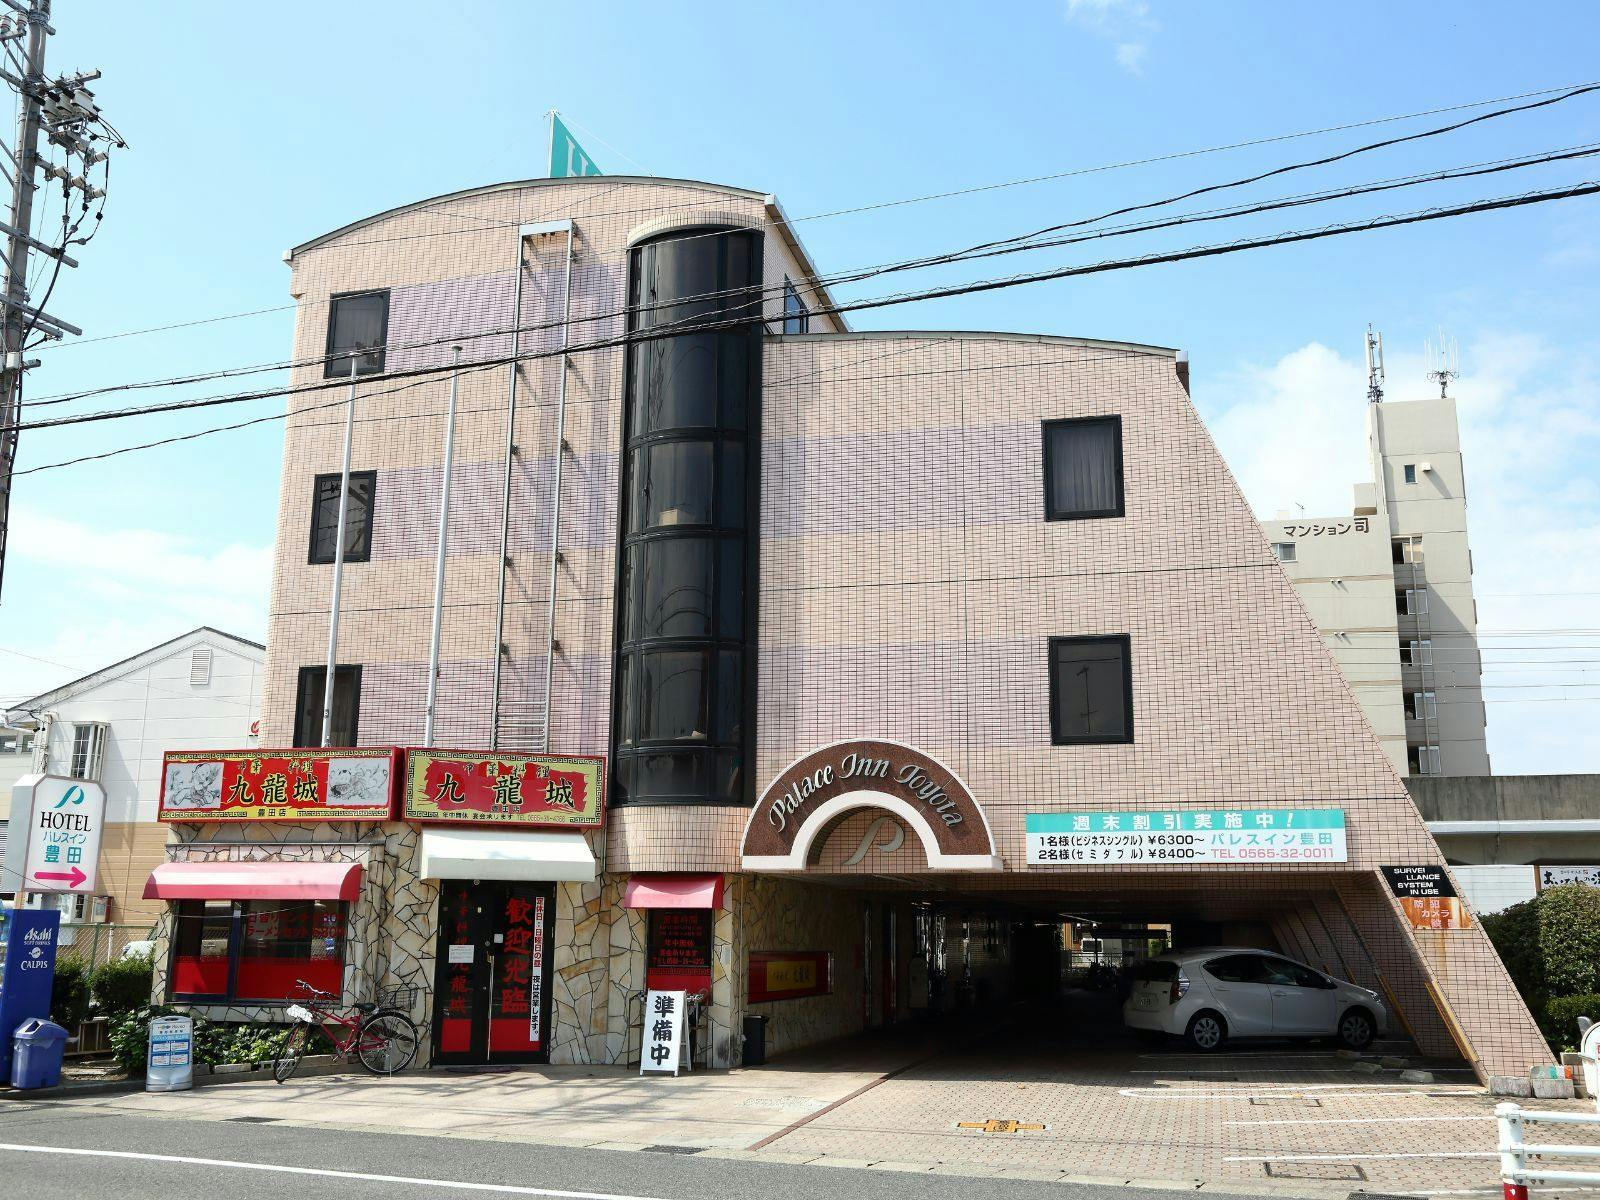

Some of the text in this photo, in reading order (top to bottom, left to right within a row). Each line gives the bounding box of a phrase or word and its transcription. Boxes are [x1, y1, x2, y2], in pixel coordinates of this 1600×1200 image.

[1284, 518, 1369, 537] マンション司
[227, 773, 319, 804] 九龍城
[434, 773, 575, 808] 九龍城
[769, 753, 964, 833] Palace Inn Toyota
[40, 811, 92, 832] HOTEL
[44, 845, 82, 864] 豊田
[1211, 848, 1235, 859] TEL
[1239, 848, 1334, 859] 0565-32-0011
[1397, 881, 1433, 889] SYSTEM
[1422, 909, 1450, 918] カメラ
[24, 928, 52, 941] Asahi
[21, 960, 48, 971] CALPIS
[651, 995, 675, 1066] 準備中
